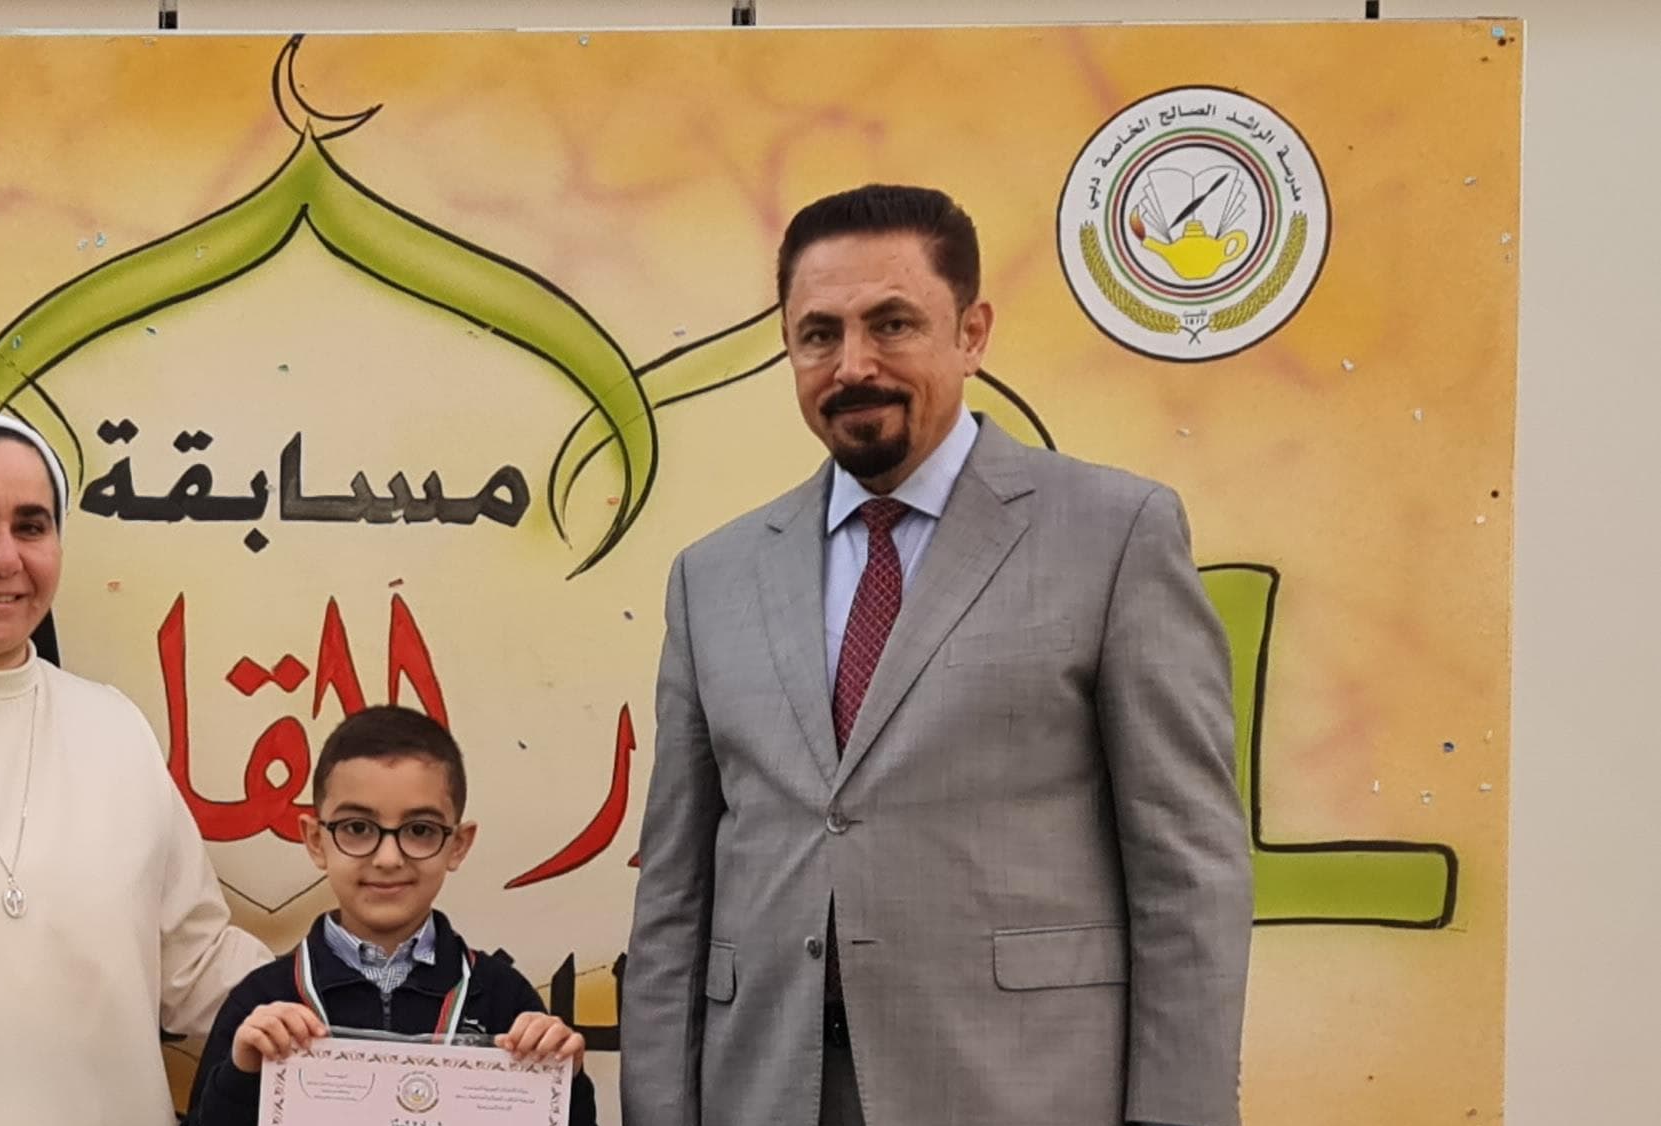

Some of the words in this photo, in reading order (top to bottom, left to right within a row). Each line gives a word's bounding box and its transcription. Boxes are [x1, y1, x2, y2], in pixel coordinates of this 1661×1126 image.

[1158, 103, 1217, 127] الصالح
[1226, 110, 1276, 144] الراشد
[1095, 117, 1151, 168] الخاصة
[1088, 176, 1101, 211] دبي
[1276, 144, 1302, 202] مدرسة
[78, 416, 532, 556] مسابقة
